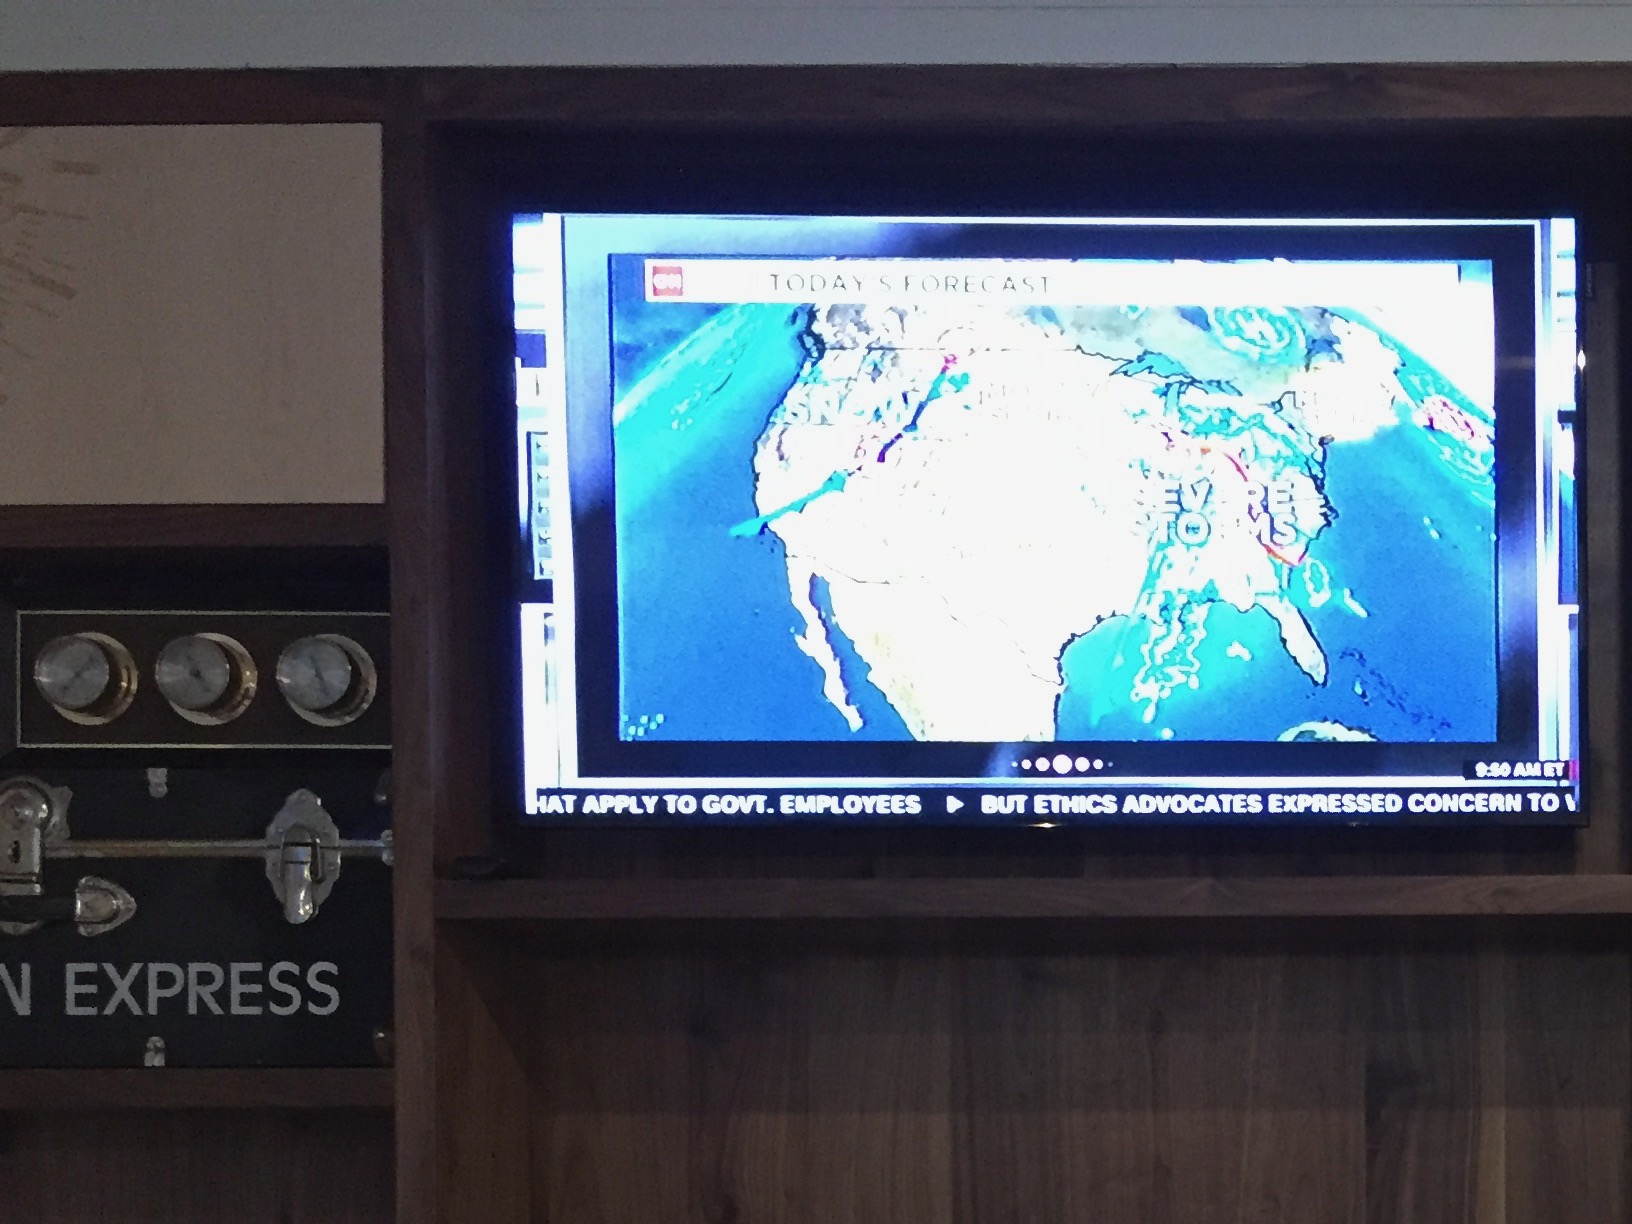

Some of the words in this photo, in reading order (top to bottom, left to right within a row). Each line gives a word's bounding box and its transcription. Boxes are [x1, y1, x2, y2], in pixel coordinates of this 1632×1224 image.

[904, 273, 1051, 294] FORECAST
[1513, 762, 1541, 777] AM
[1543, 762, 1565, 777] ET
[582, 795, 660, 815] APPLY
[665, 795, 698, 815] TO
[702, 795, 775, 815] GOVT.
[779, 794, 922, 815] EMPLOYEES
[981, 794, 1028, 814] BUT
[1033, 794, 1118, 814] ETHICS
[1122, 794, 1262, 814] ADVOCATES
[1267, 794, 1400, 814] EXPRESSED
[1407, 793, 1522, 813] CONCERN
[1527, 793, 1560, 813] TO
[65, 960, 342, 1018] EXPRESS
